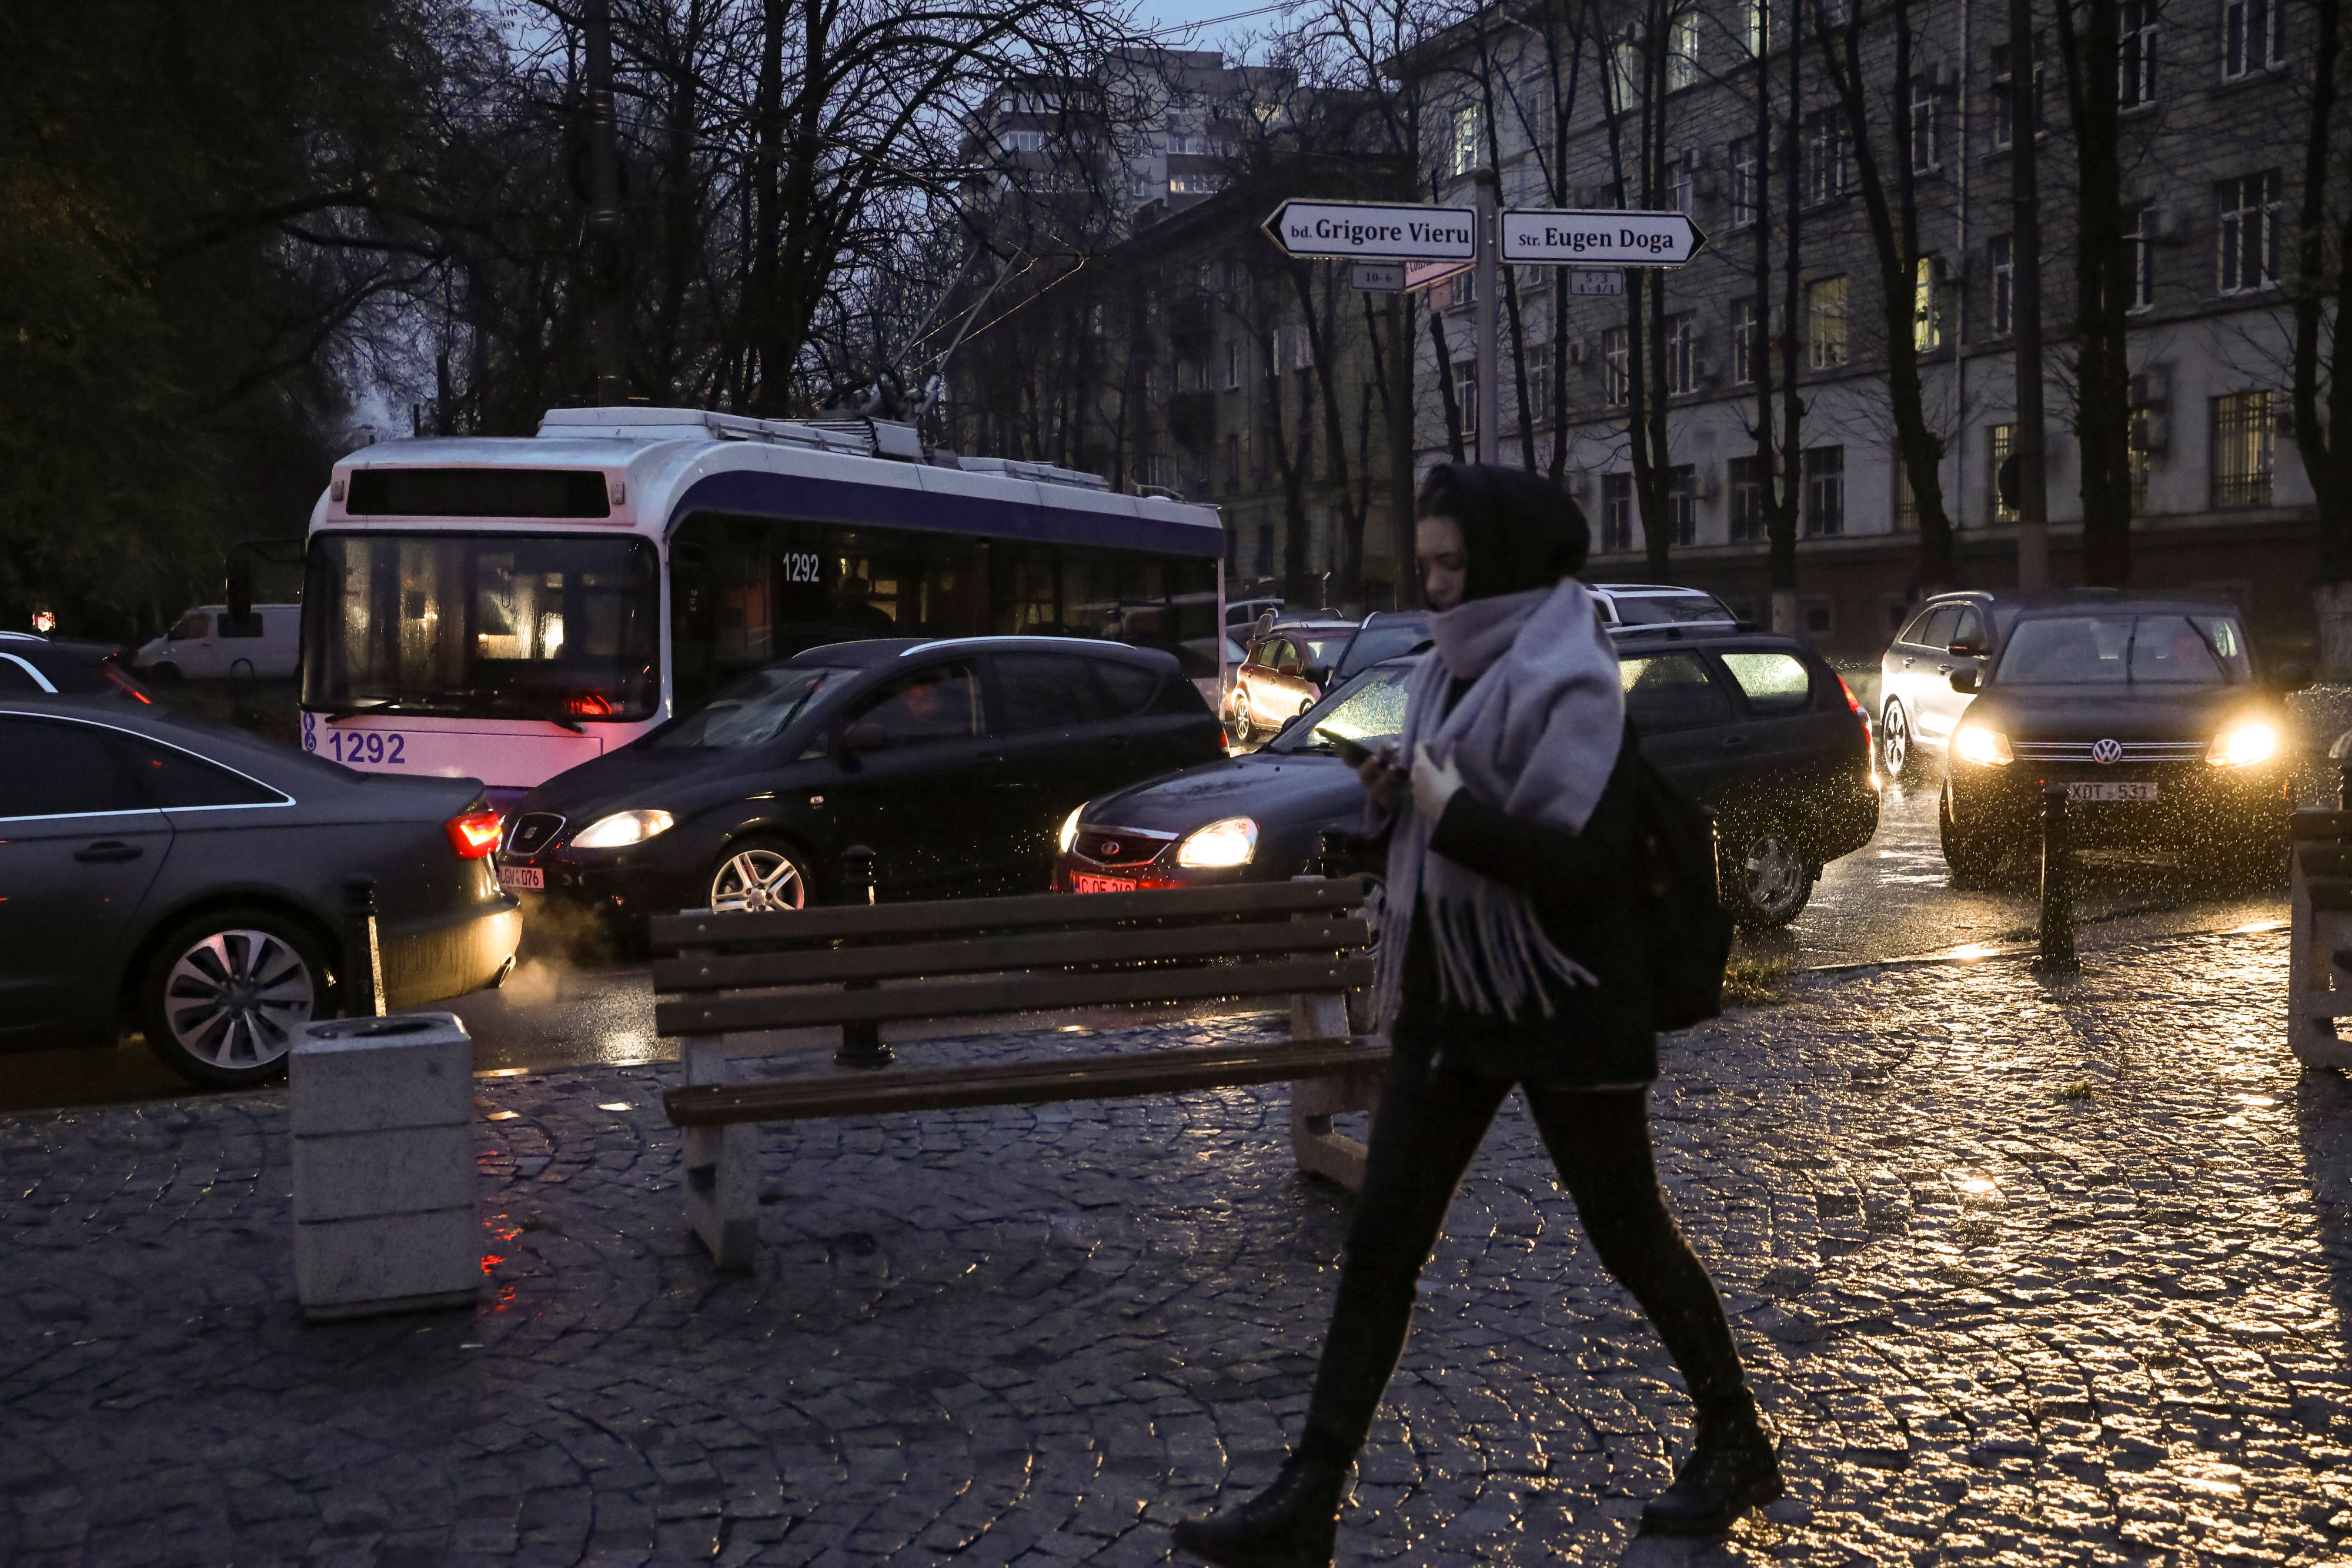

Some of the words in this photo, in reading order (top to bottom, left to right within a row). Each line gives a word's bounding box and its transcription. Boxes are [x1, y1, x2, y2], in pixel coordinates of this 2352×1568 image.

[1291, 226, 1312, 238] bd.
[1315, 213, 1402, 246] Grigore
[1408, 217, 1469, 244] Vieru
[1519, 234, 1541, 246] Str.
[1545, 228, 1612, 252] Eugen
[1619, 229, 1673, 253] Doga
[783, 552, 820, 582] 1292
[329, 731, 405, 764] 1292
[2072, 784, 2103, 800] XDT
[522, 870, 539, 887] 076
